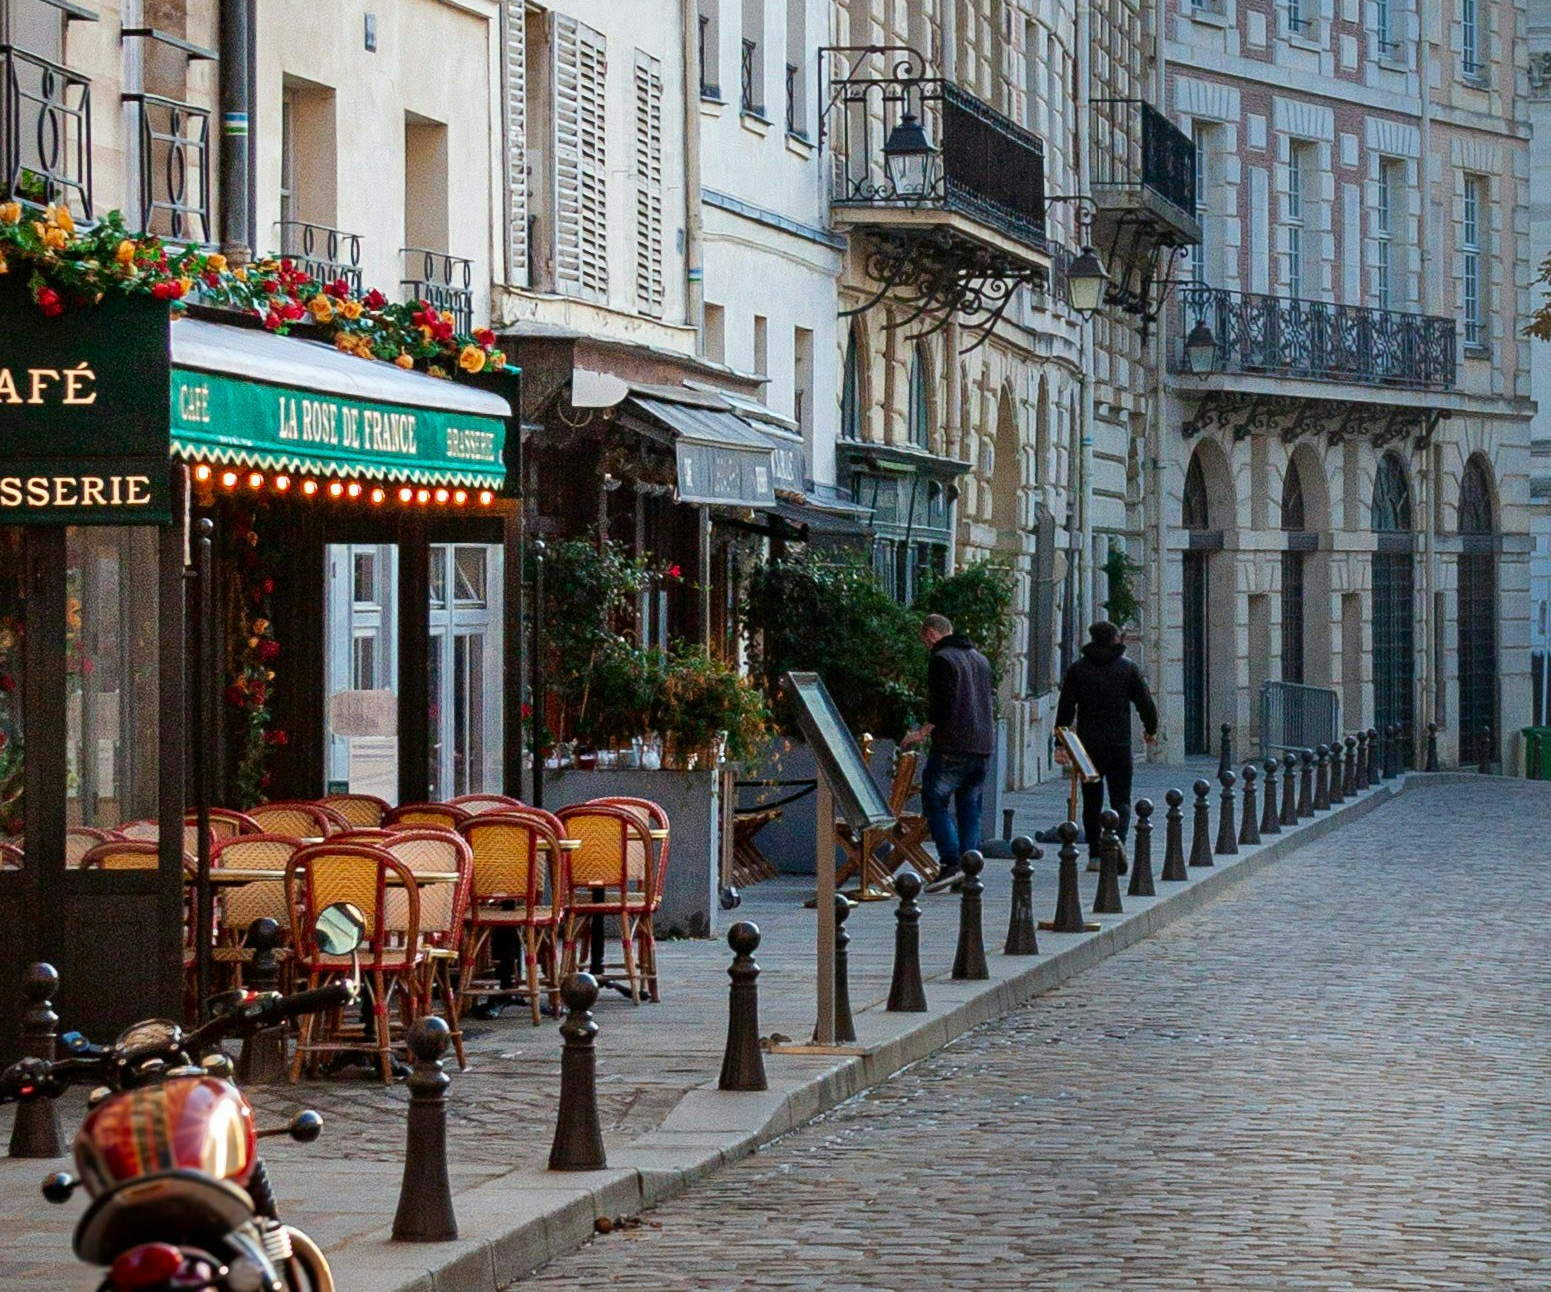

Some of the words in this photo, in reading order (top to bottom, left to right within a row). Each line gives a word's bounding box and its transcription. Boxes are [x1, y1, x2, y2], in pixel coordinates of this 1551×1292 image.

[0, 361, 97, 405] AFÉ
[279, 396, 298, 439] LA
[301, 399, 339, 445] ROSE
[342, 406, 360, 449] DE
[363, 410, 417, 454] FRANCE
[0, 475, 151, 506] SSERIE
